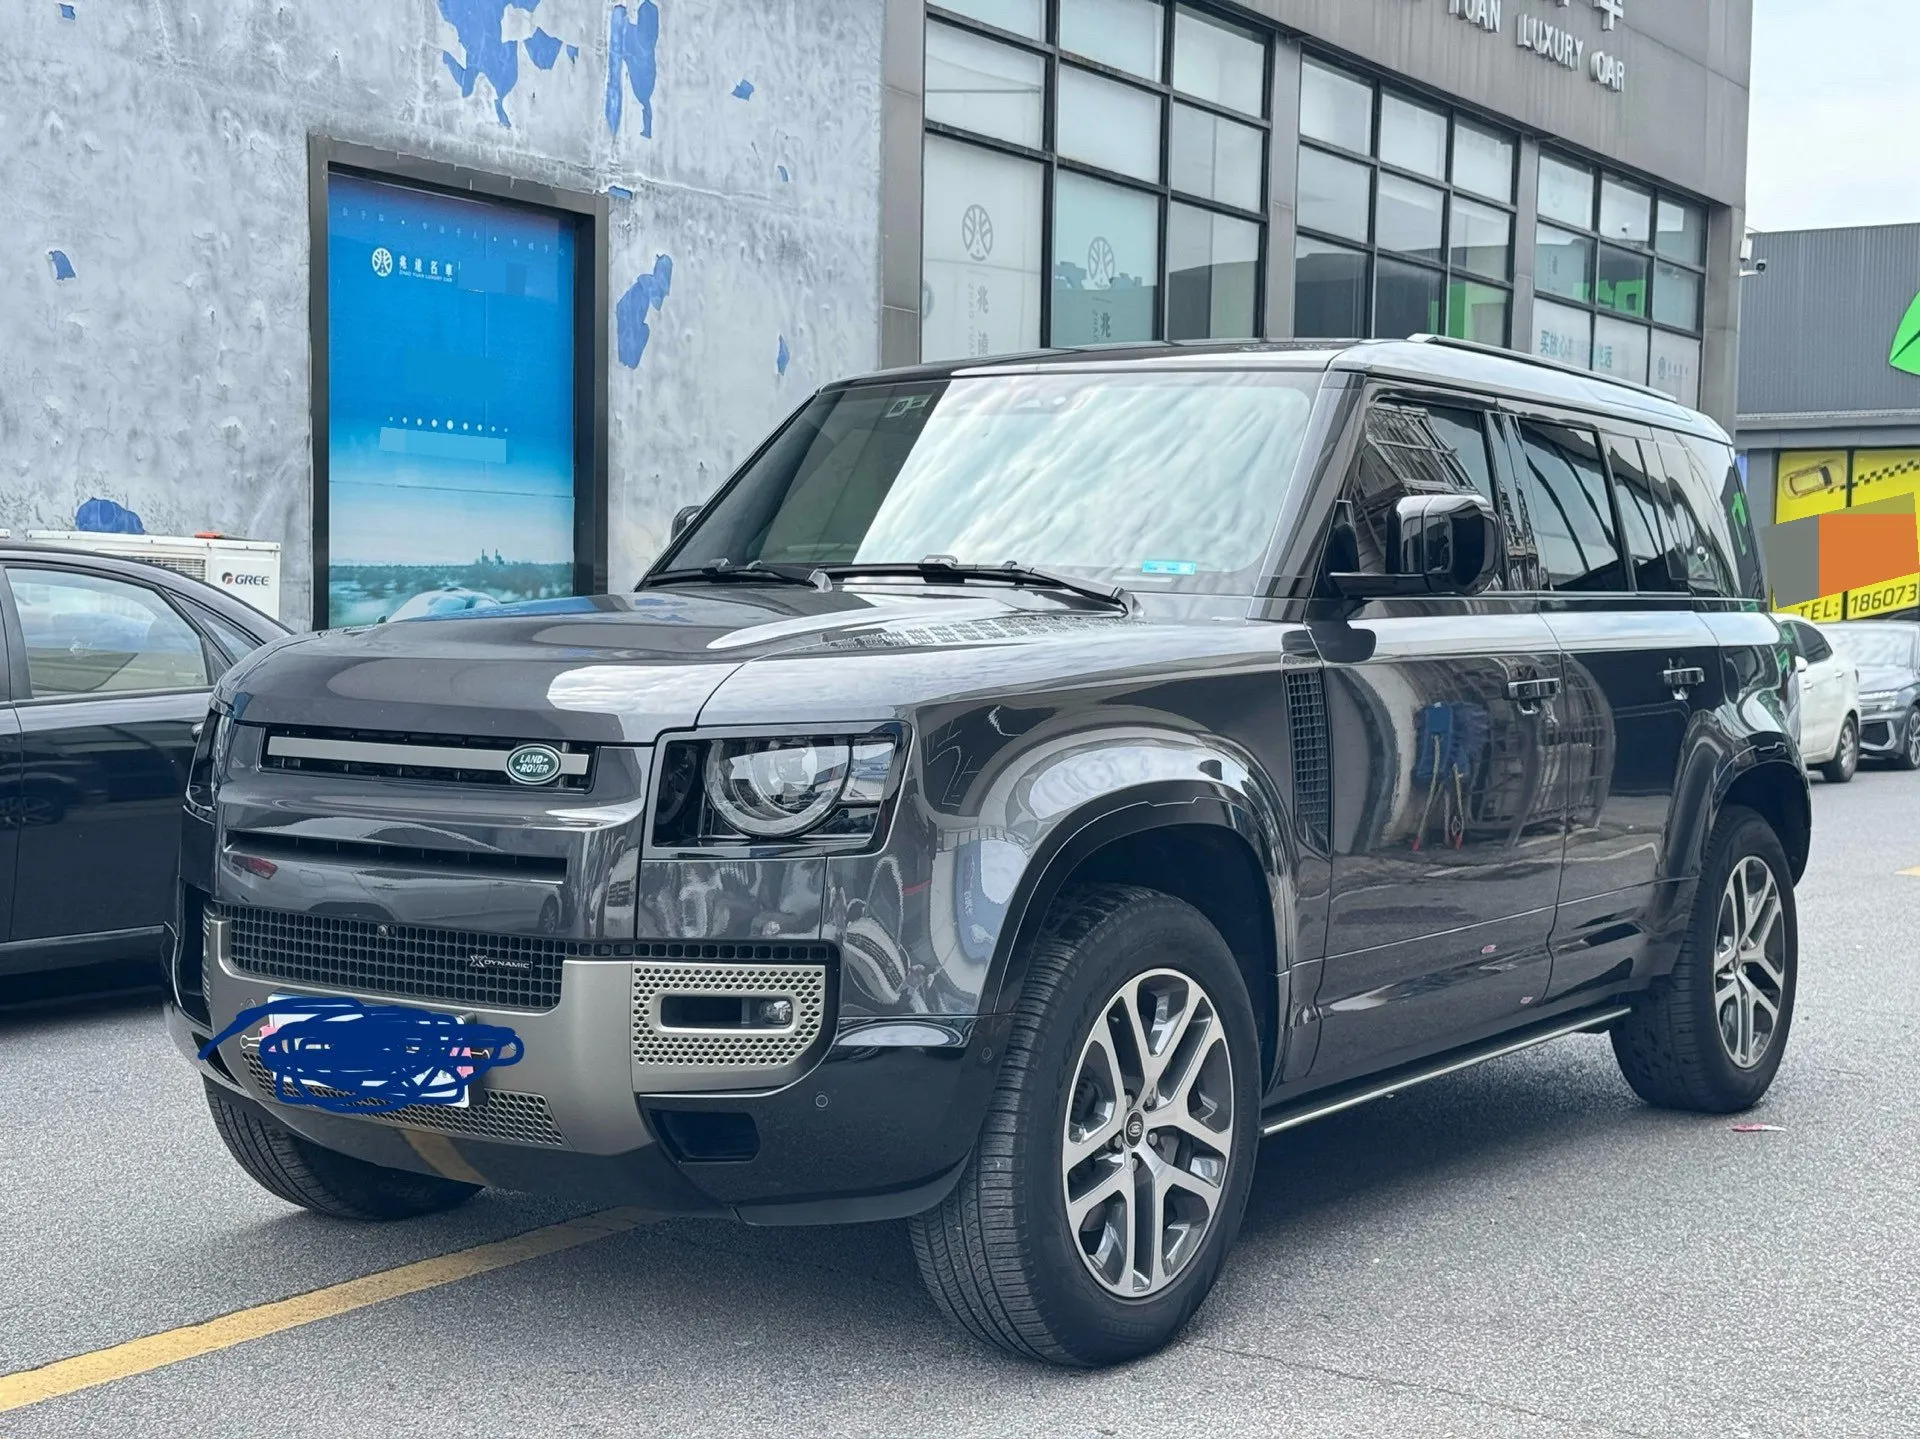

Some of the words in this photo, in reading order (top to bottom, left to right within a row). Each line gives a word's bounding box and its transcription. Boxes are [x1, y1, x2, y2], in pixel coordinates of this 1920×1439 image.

[1517, 14, 1584, 71] LUXURY
[1590, 50, 1625, 93] CAR
[235, 574, 270, 586] GREE
[1799, 600, 1839, 620] TEL:
[1851, 583, 1918, 614] 186073
